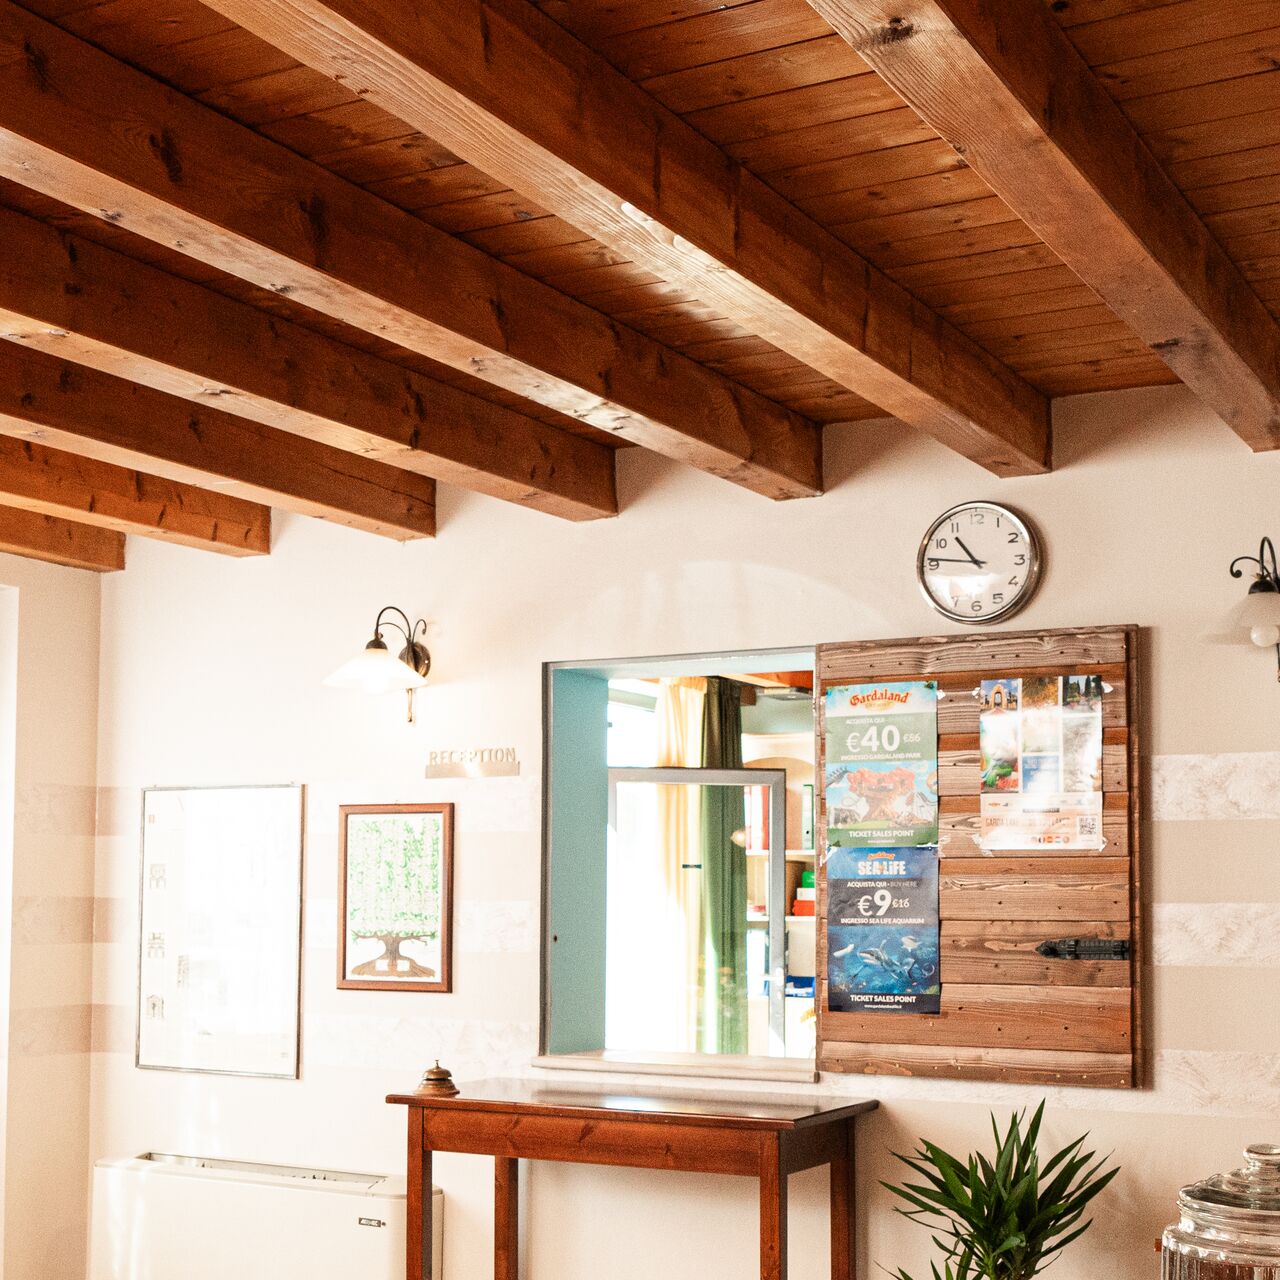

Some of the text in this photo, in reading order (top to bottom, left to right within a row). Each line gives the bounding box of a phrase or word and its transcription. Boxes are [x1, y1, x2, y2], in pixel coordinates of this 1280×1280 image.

[952, 522, 959, 533] 11
[1008, 533, 1019, 543] 2
[936, 539, 947, 549] 10
[929, 560, 939, 571] 9
[1014, 554, 1025, 566] 3
[1008, 576, 1018, 586] 4
[992, 593, 1003, 604] 5
[971, 601, 982, 612] 6
[850, 689, 910, 706] Gardaland
[846, 725, 900, 752] €40
[429, 748, 515, 765] RECEPTION
[858, 861, 880, 875] SEA
[858, 889, 892, 916] €9
